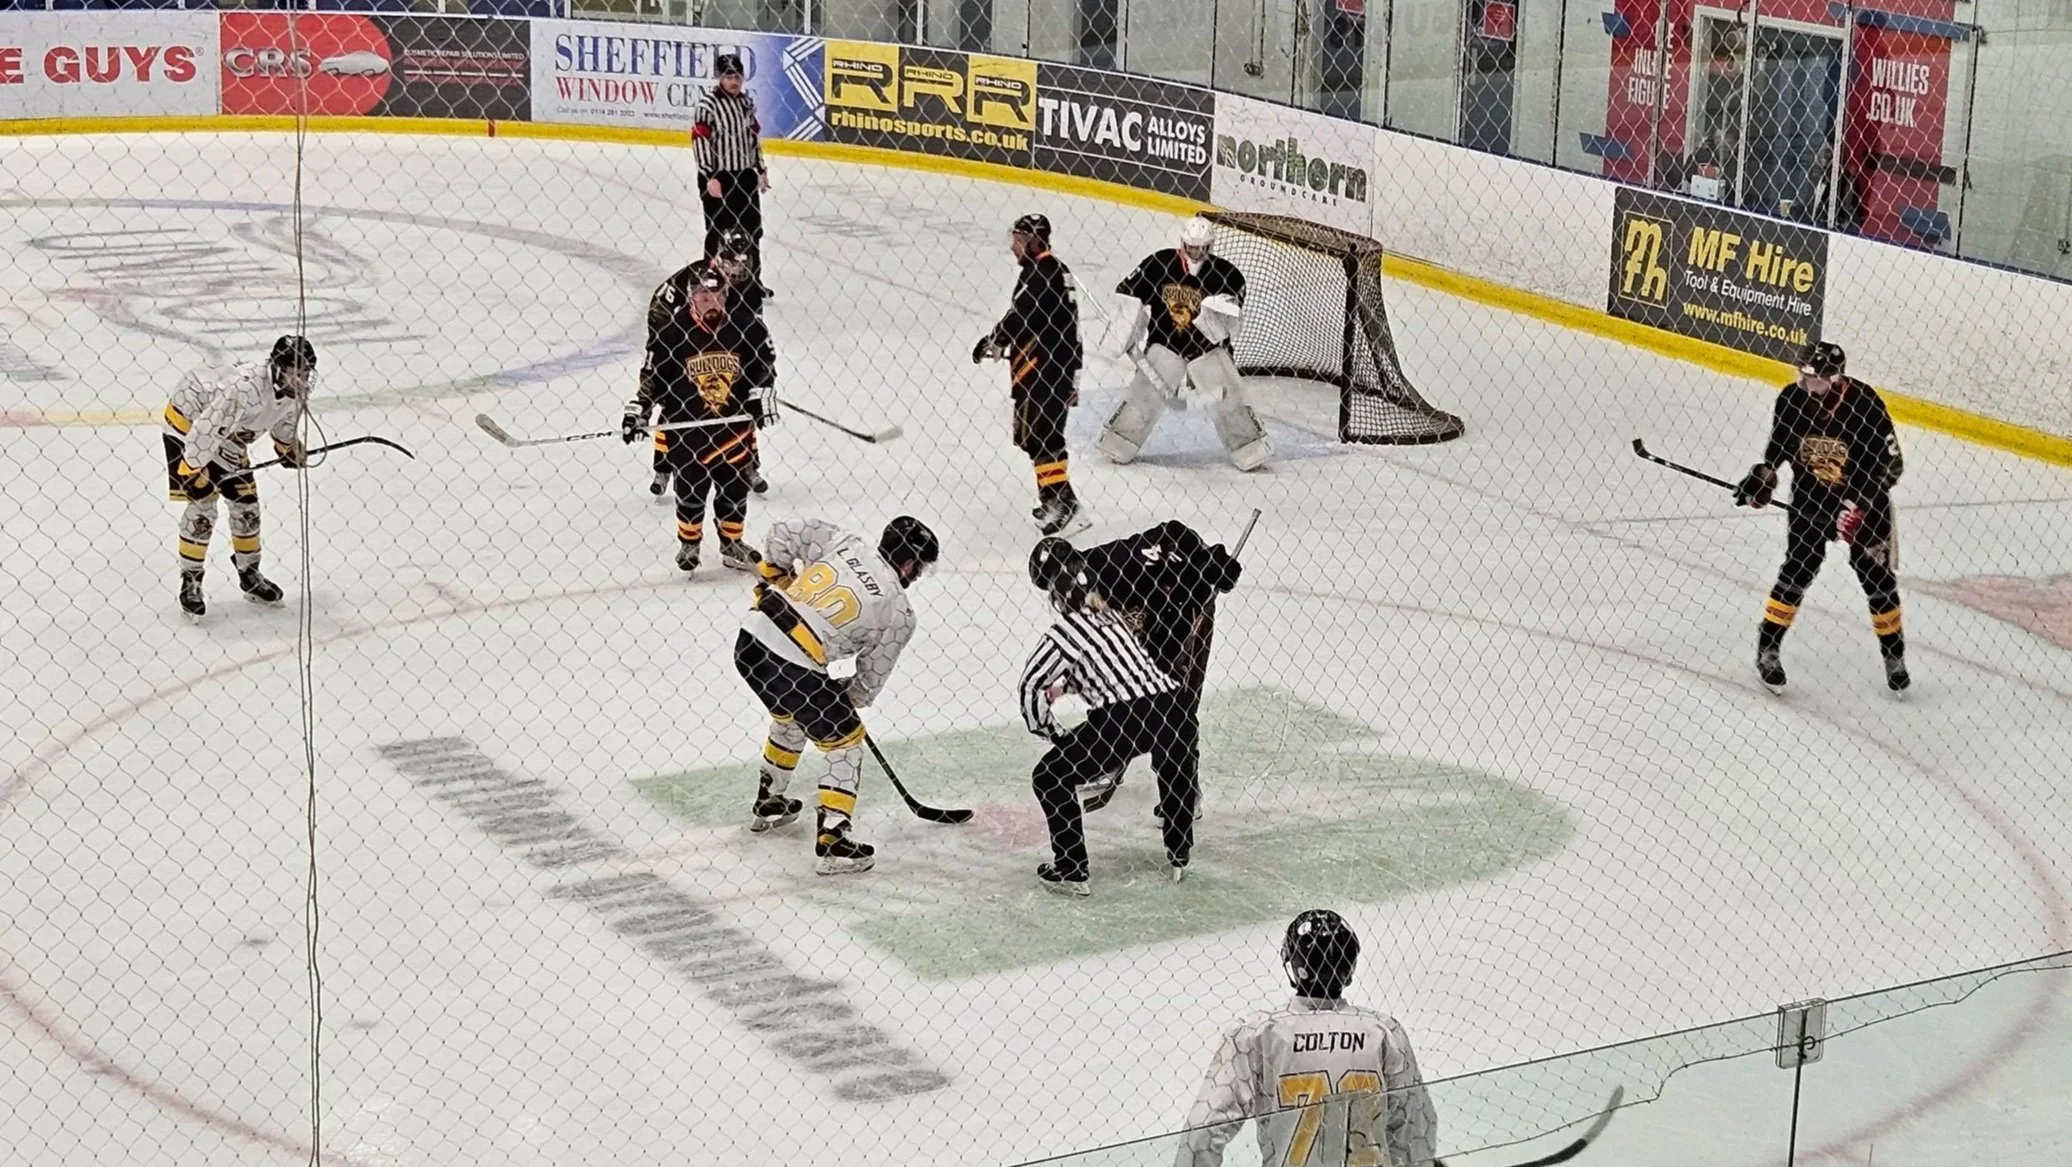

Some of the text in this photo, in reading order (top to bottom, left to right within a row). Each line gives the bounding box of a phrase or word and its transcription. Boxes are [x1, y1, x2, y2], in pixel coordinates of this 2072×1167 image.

[44, 46, 196, 84] GUYS
[555, 34, 757, 82] SHEFFIELD
[833, 60, 883, 72] RHINO
[906, 68, 954, 80] RHINO
[1634, 47, 1672, 79] INLIE
[555, 77, 659, 104] WINDOW
[975, 77, 1022, 89] RHINO
[1628, 76, 1671, 109] FIGUE
[1872, 57, 1929, 95] WILLIES
[831, 111, 1029, 151] rhinosports.co.uk
[1038, 97, 1143, 152] TIVAC
[1147, 116, 1205, 144] ALLOYS
[1147, 136, 1206, 165] LIMITED
[1216, 134, 1367, 203] northern
[1240, 174, 1337, 206] GROUNDCARE
[1687, 226, 1814, 293] MF Hire
[1685, 270, 1812, 317] Tool & Equipment Hire
[1683, 300, 1808, 346] www.mfhire.co.uk
[566, 431, 612, 442] CCM
[786, 560, 863, 630] 80
[846, 558, 884, 597] GLASBY
[1293, 1031, 1365, 1054] COLTON
